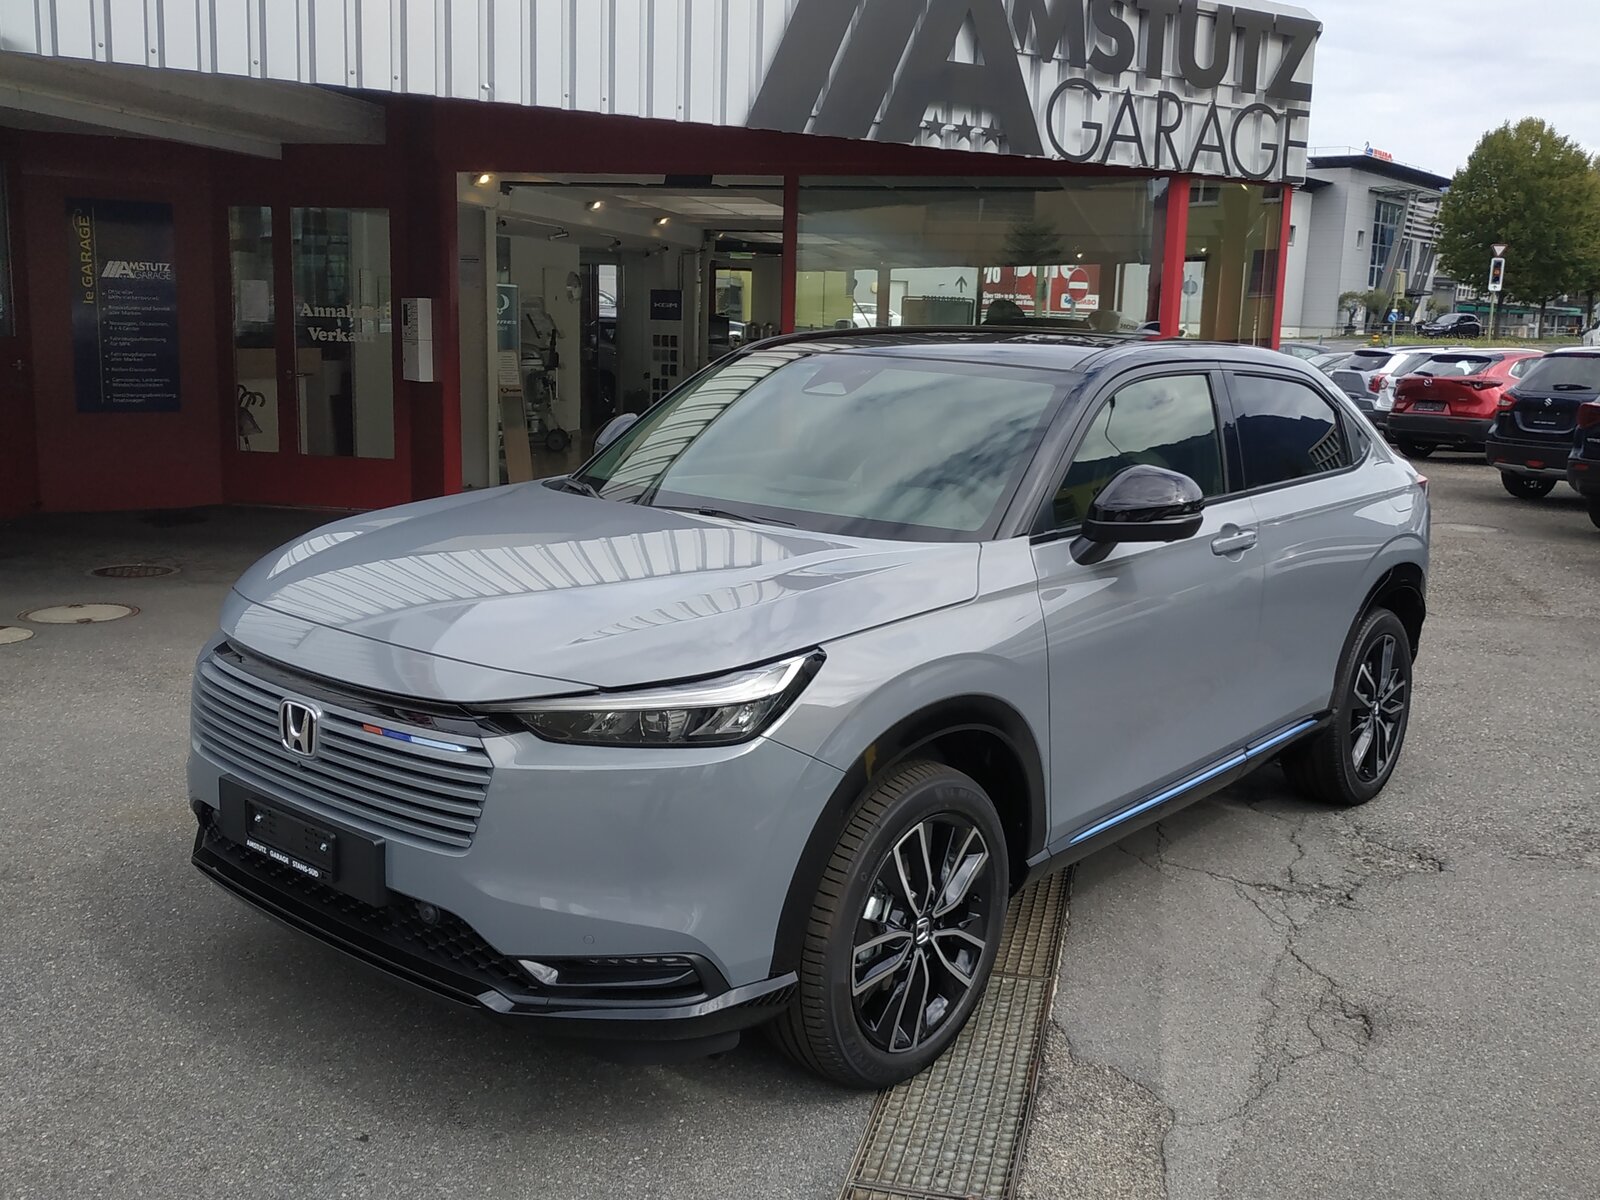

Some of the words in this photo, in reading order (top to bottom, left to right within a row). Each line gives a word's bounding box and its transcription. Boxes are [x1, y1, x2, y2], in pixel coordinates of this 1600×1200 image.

[1046, 78, 1310, 184] GARAGE
[79, 215, 93, 287] GARAGE
[115, 261, 171, 278] AMSTUTZ
[134, 271, 172, 280] GARAGE
[307, 326, 375, 343] Verka
[246, 839, 268, 855] AMSTUTZ
[269, 850, 290, 865] GARAGE
